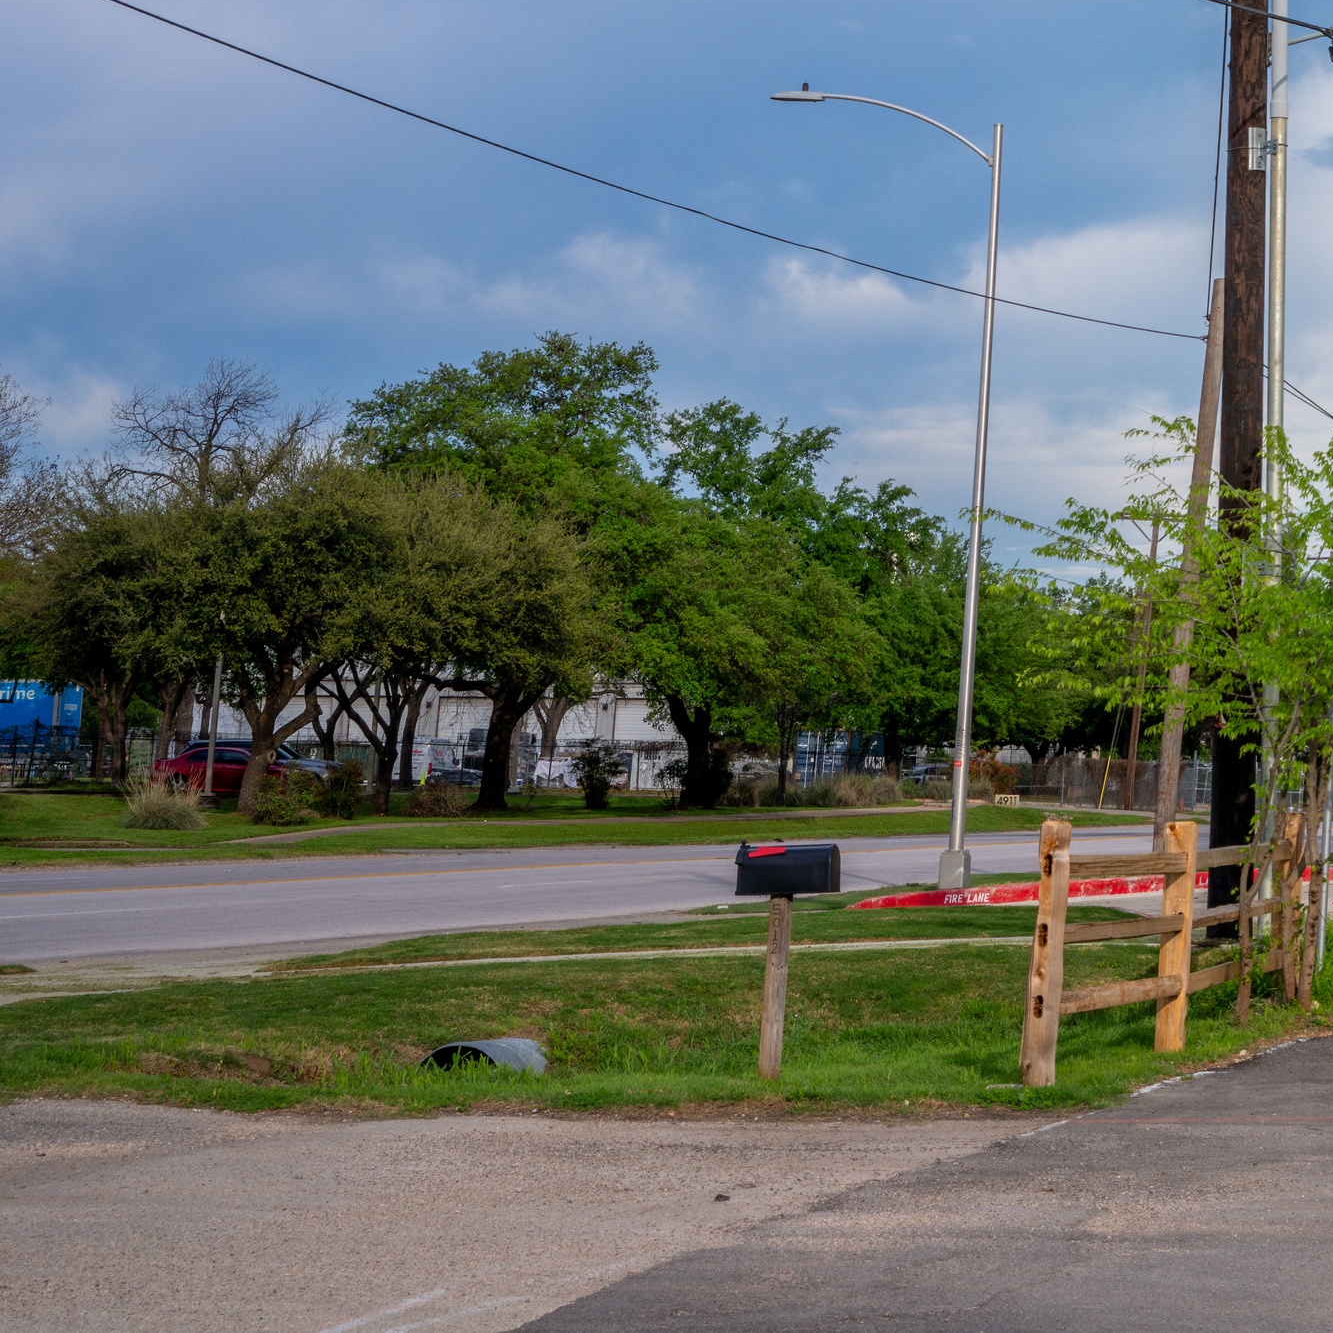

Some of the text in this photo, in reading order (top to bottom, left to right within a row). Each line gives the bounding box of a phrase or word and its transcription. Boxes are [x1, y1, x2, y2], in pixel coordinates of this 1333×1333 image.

[0, 686, 35, 700] rime
[997, 796, 1017, 805] 4911
[944, 892, 991, 904] FIRE LANE
[771, 903, 782, 954] 5012
